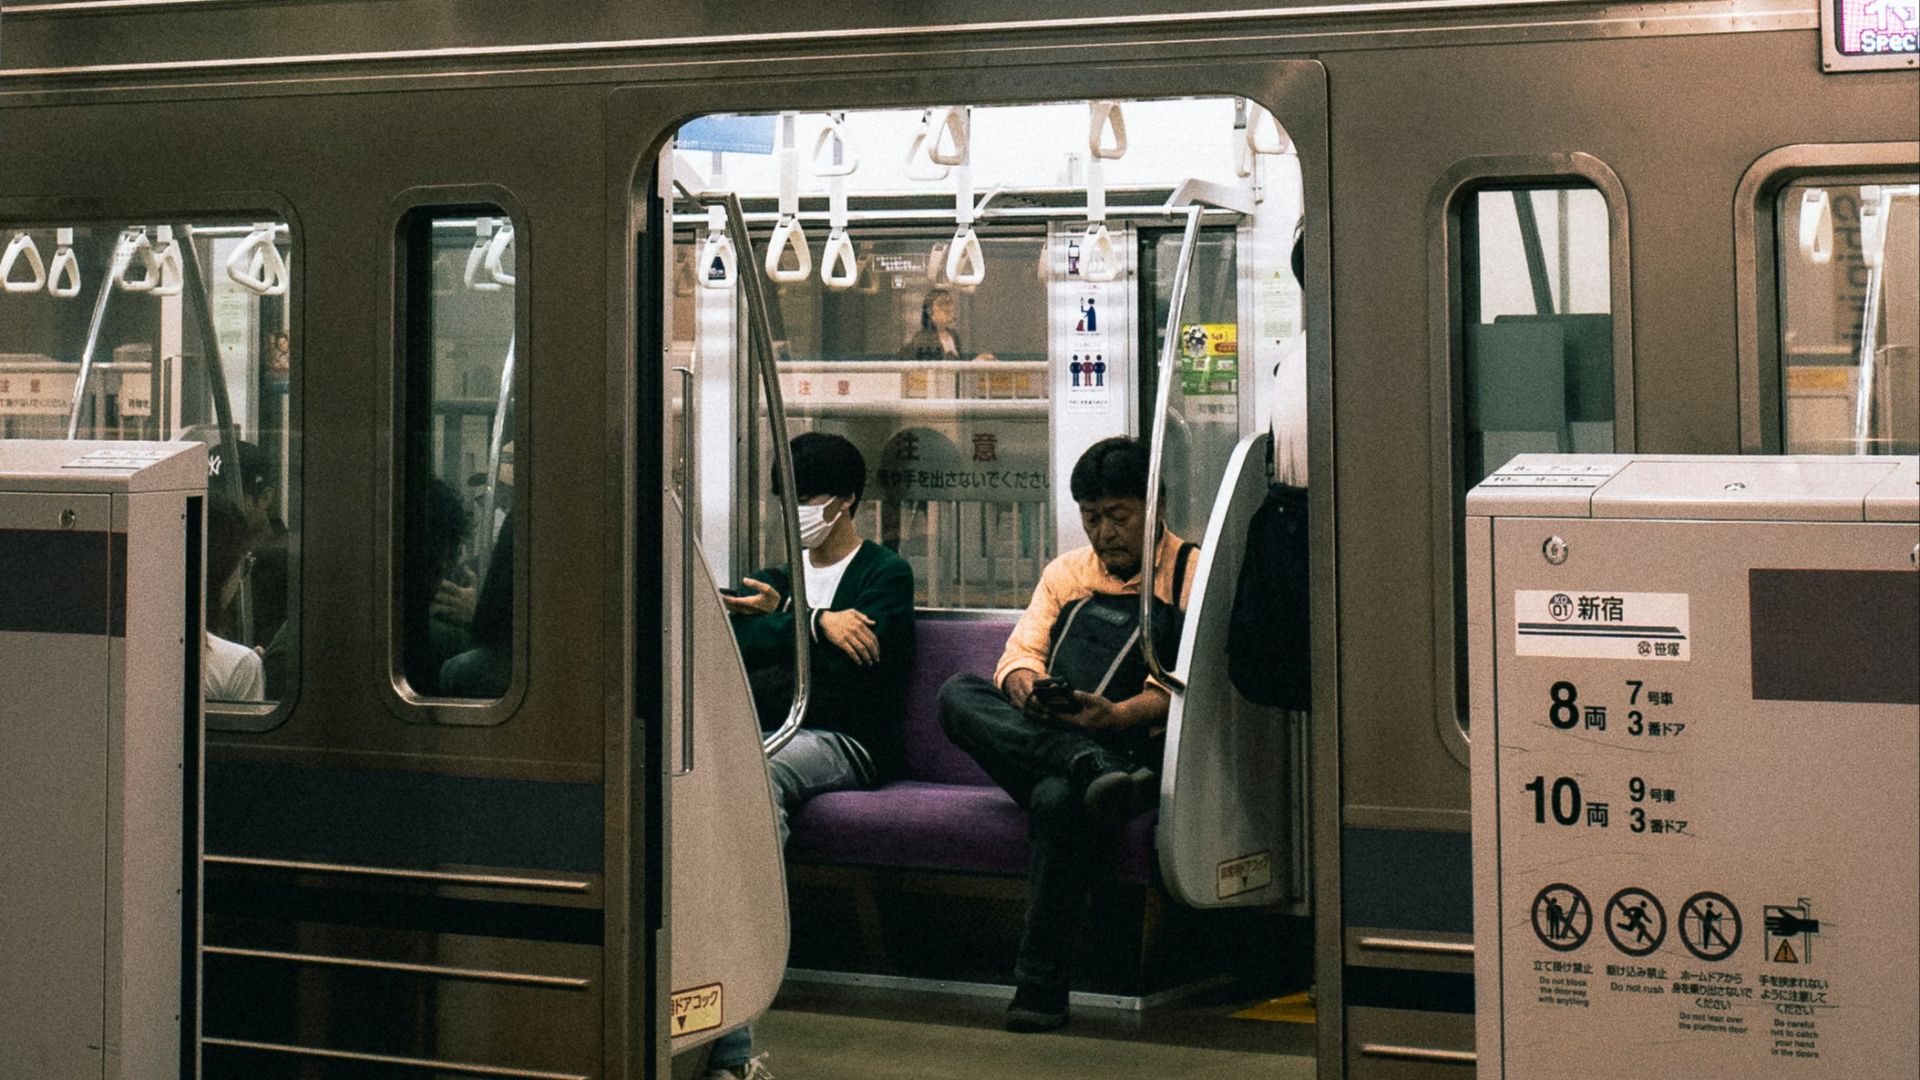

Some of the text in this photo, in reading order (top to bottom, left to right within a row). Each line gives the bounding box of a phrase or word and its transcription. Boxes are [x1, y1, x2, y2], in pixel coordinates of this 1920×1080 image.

[1860, 29, 1920, 52] Spec
[1553, 604, 1568, 617] 01
[1577, 595, 1624, 621] 新宿
[1654, 642, 1680, 656] 笹塚
[1610, 982, 1665, 994] Do not rush
[1695, 998, 1731, 1010] ください
